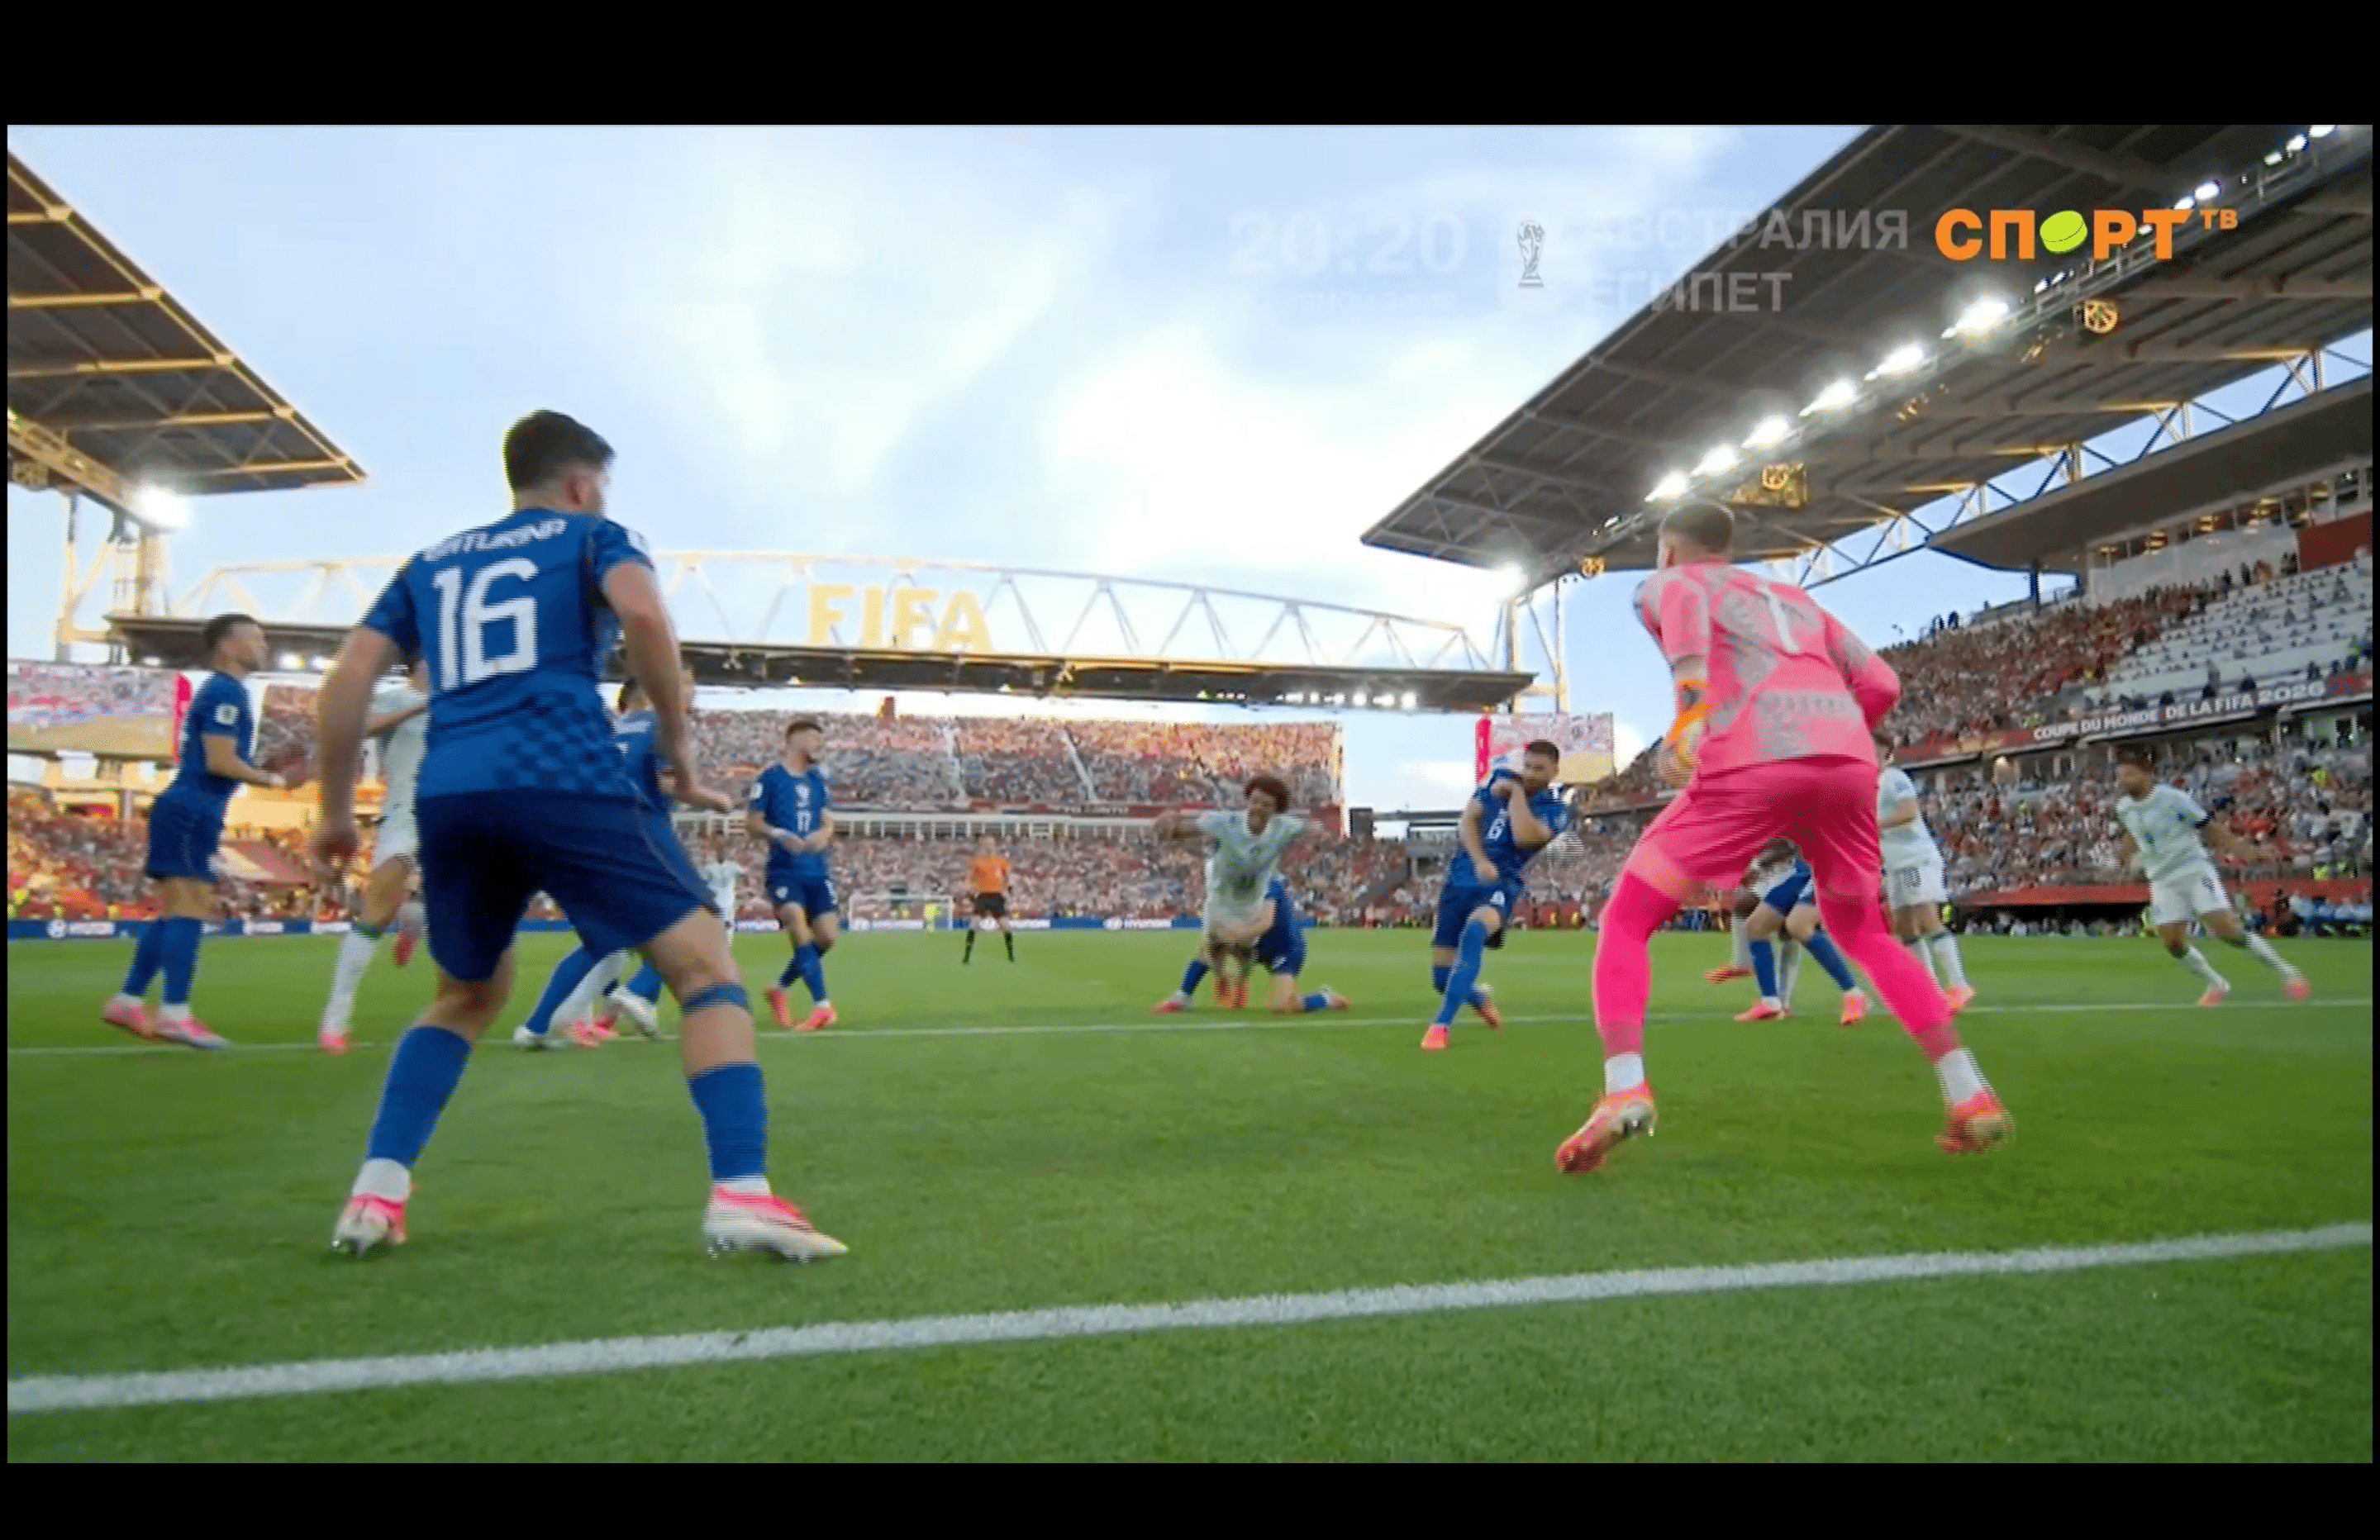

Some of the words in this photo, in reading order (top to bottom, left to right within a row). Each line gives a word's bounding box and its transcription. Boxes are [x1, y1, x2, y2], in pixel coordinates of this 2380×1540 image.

[431, 557, 540, 691] 16
[807, 582, 995, 654] FIFA
[2033, 721, 2079, 741] COUPE
[2080, 716, 2102, 734] DU
[2103, 709, 2159, 731] MONDE
[2165, 705, 2187, 719] DE
[2189, 701, 2212, 716] LA
[2215, 693, 2255, 713] FIFA
[2257, 681, 2326, 705] 2026
